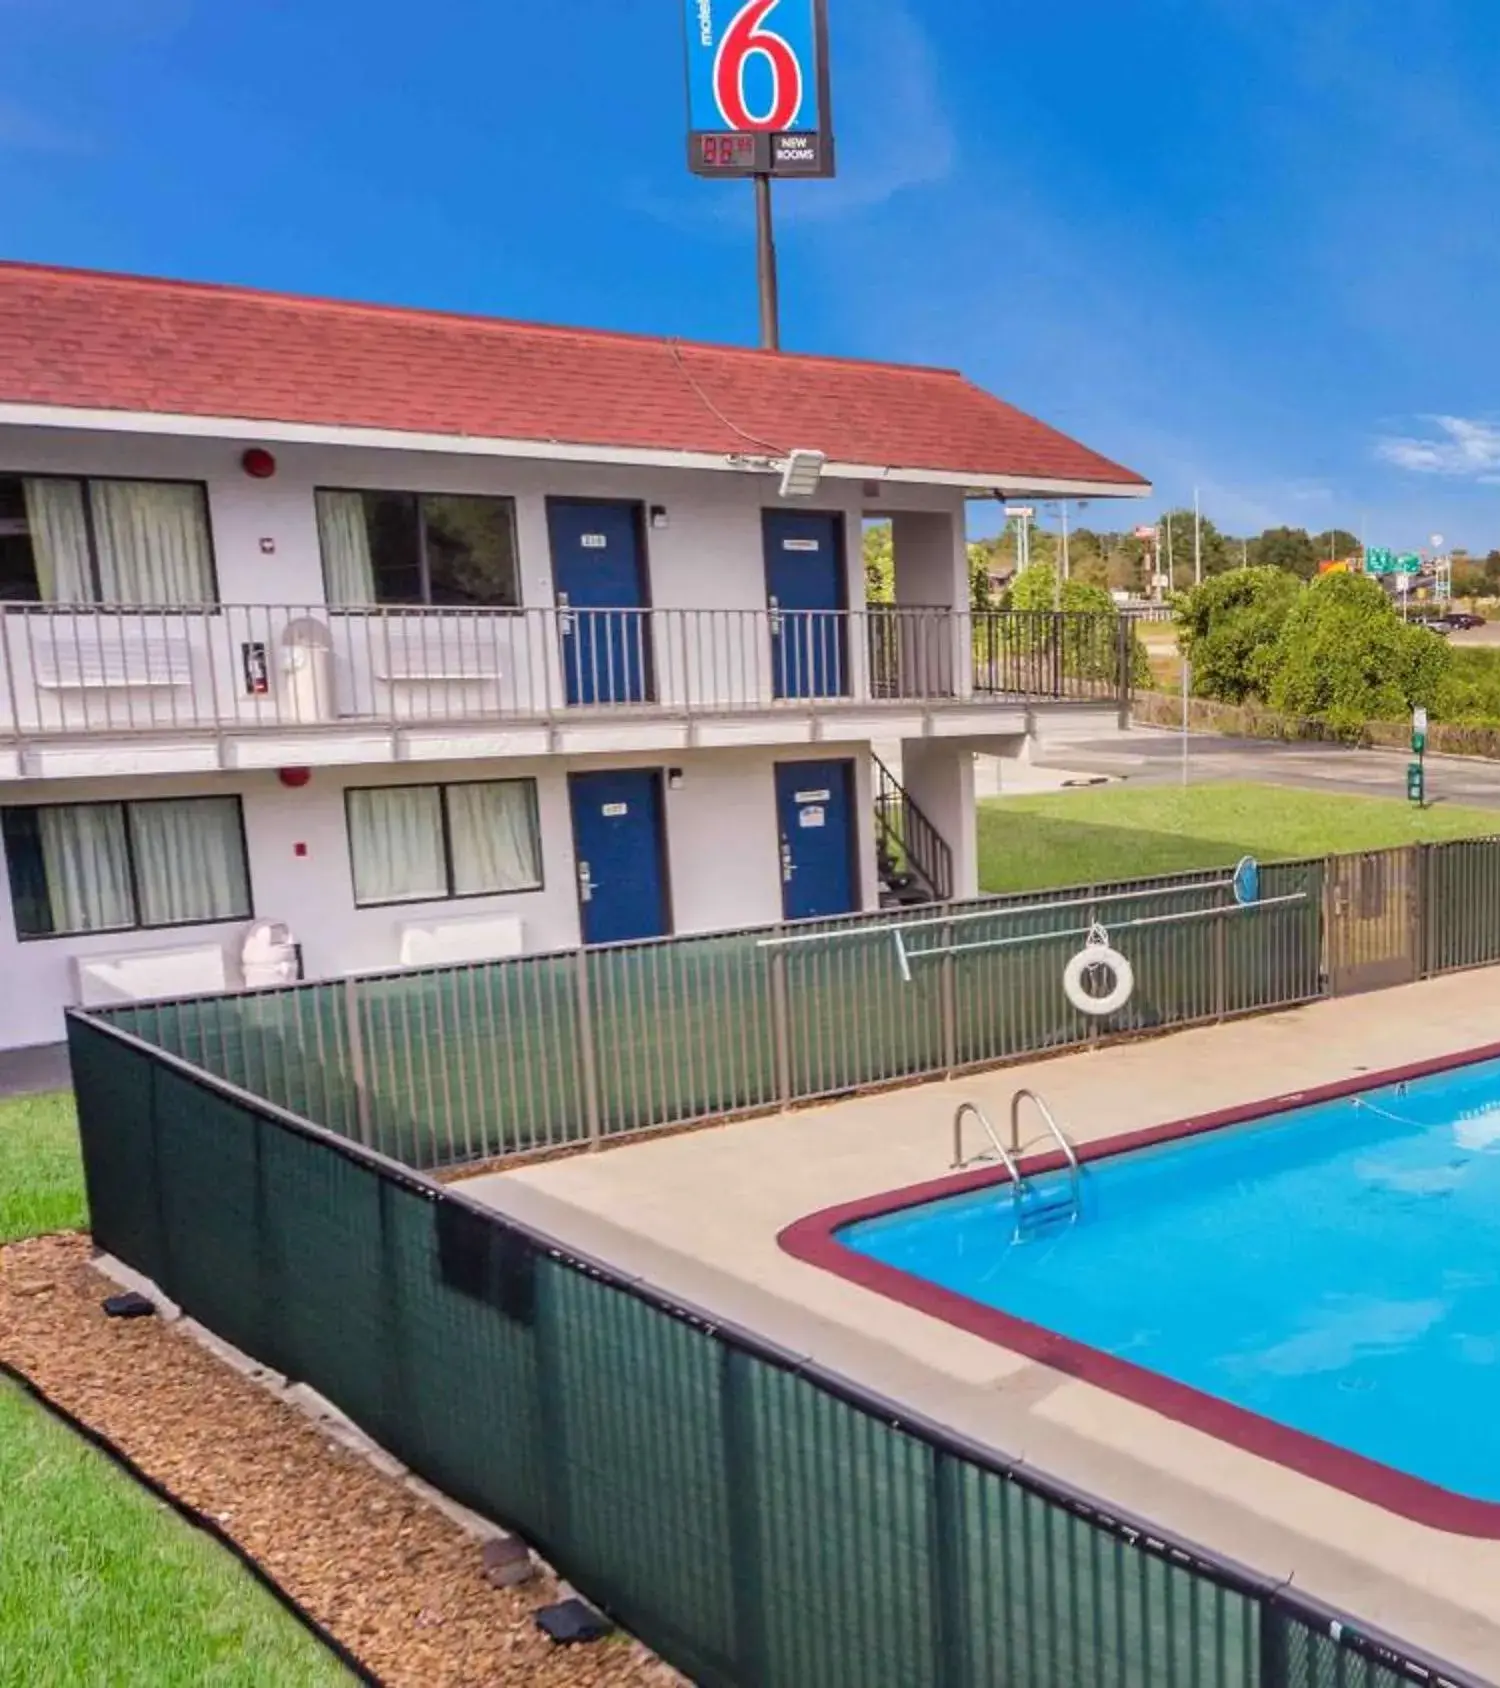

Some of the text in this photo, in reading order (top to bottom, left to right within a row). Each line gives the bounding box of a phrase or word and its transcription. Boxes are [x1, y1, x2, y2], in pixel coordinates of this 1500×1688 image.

[712, 0, 802, 130] 6
[781, 137, 807, 148] NEW
[777, 149, 814, 160] ROOMS
